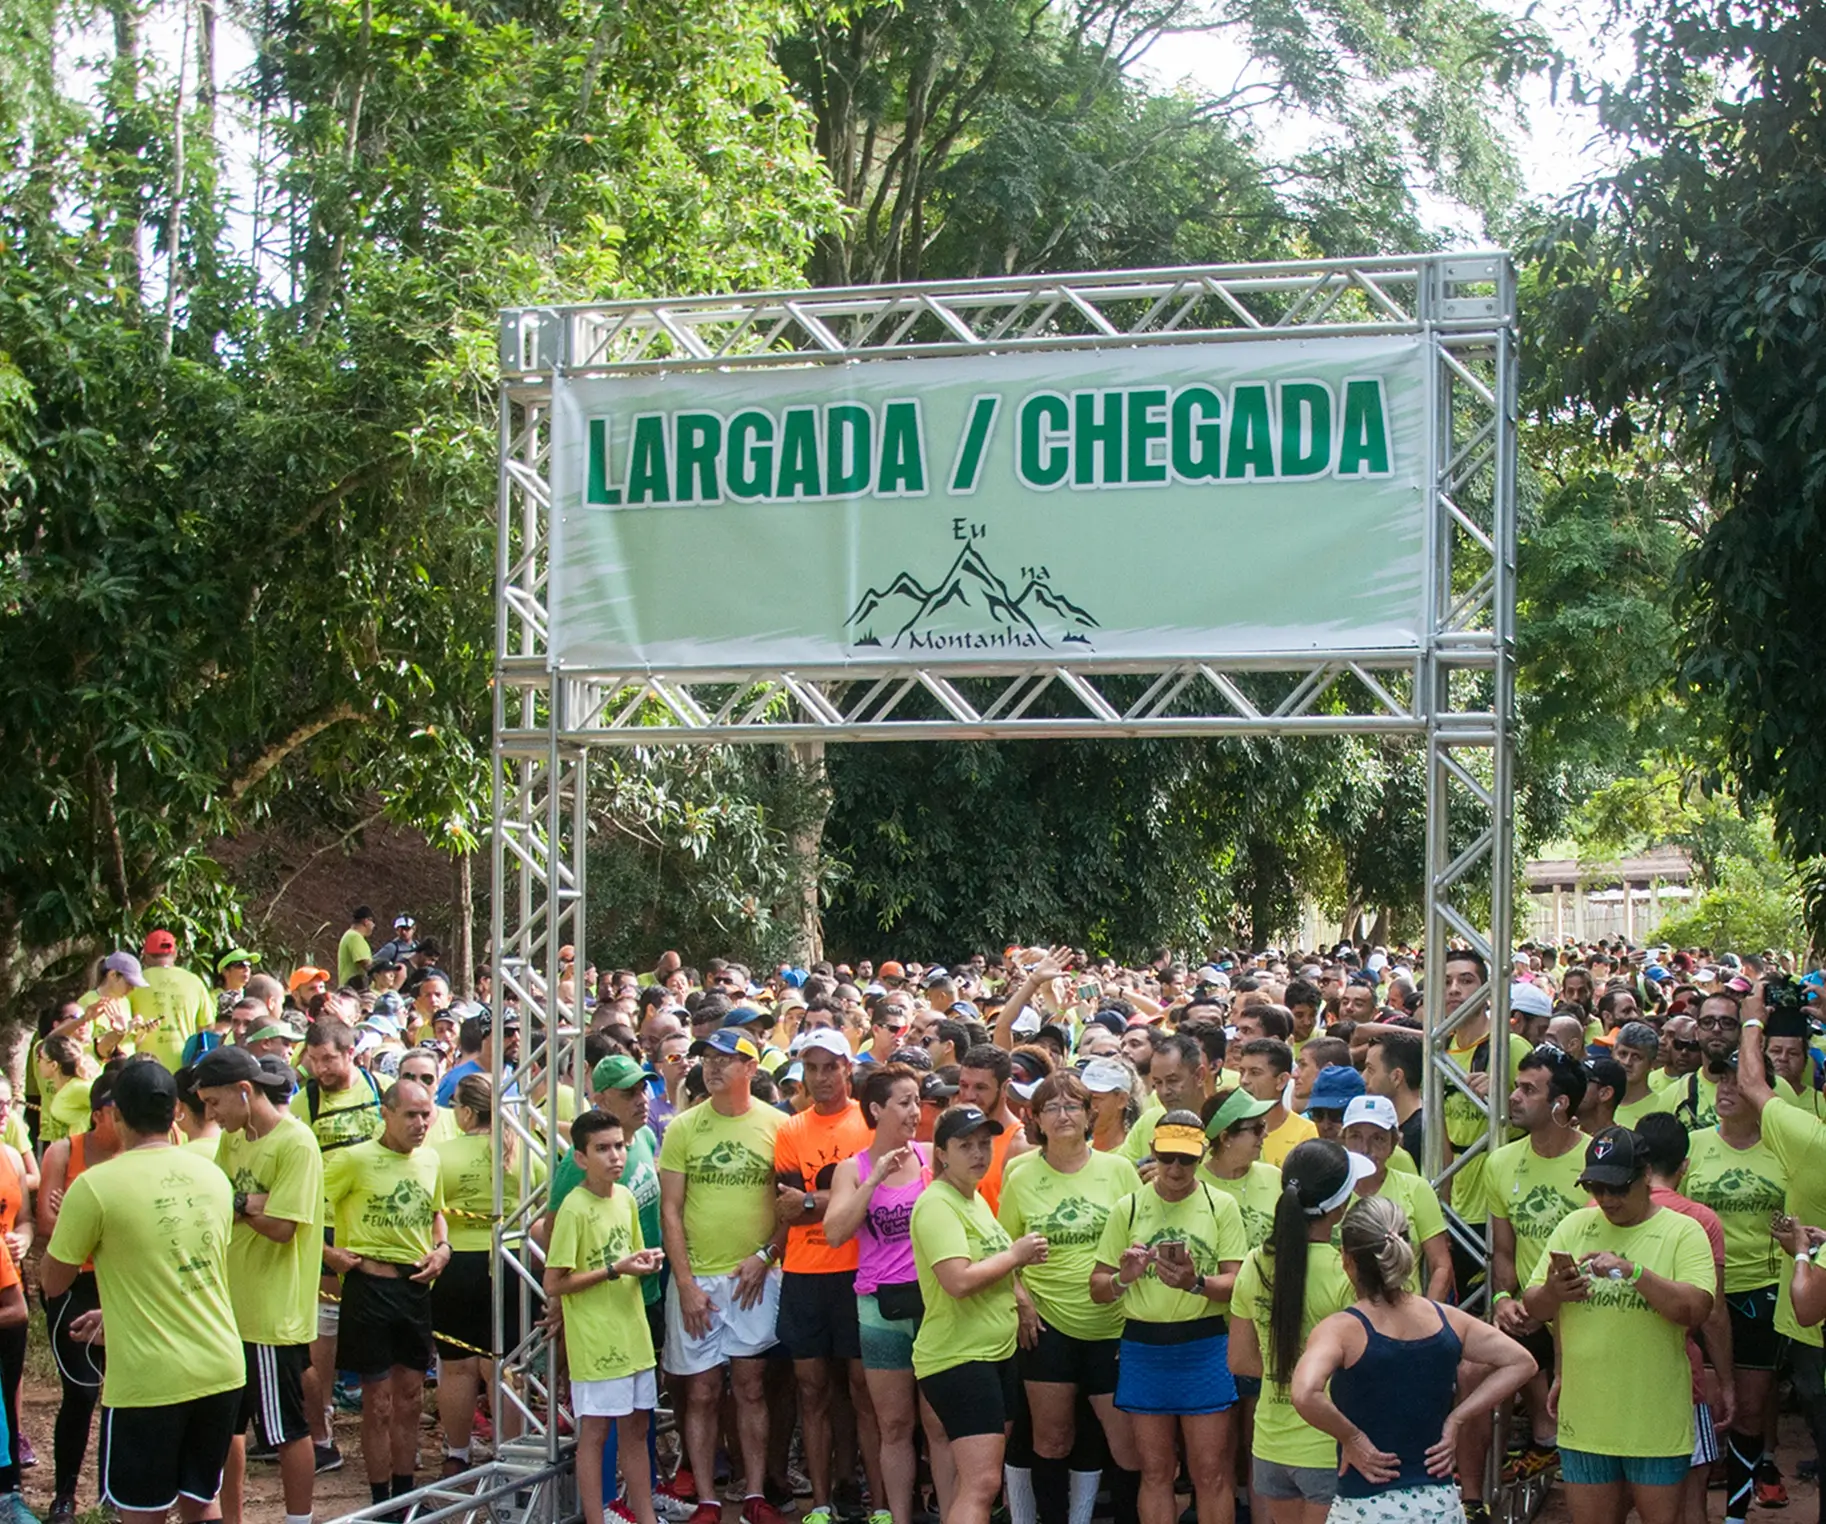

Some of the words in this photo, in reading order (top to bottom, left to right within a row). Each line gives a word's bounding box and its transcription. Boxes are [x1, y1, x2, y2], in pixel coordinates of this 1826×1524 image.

[584, 400, 927, 509] LARGADA
[951, 397, 999, 492] /
[1018, 379, 1391, 488] CHEGADA
[951, 517, 987, 541] Eu
[1020, 565, 1051, 580] na
[908, 625, 1037, 651] Montanha
